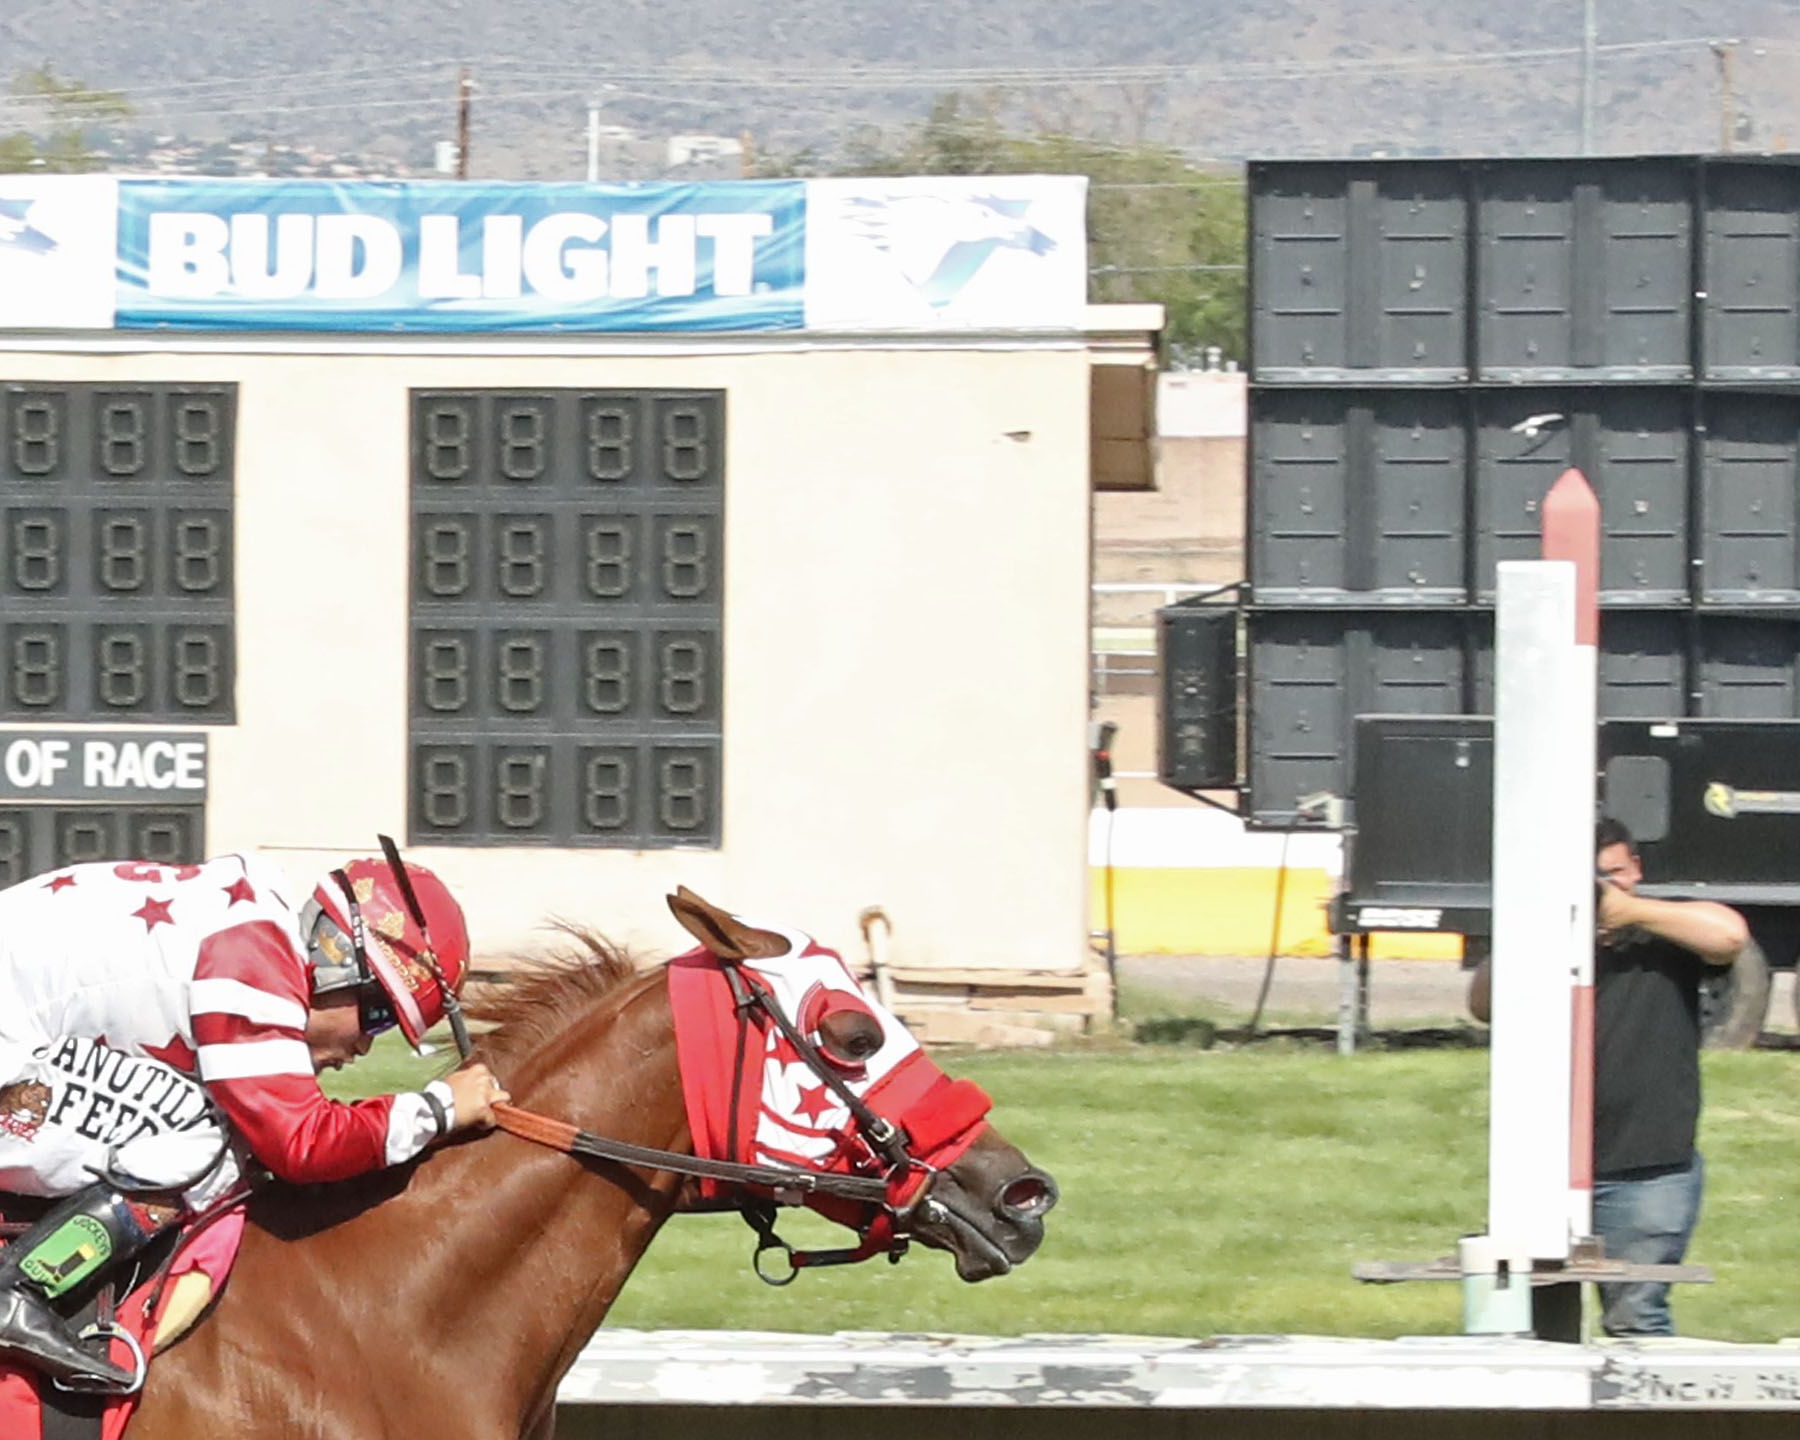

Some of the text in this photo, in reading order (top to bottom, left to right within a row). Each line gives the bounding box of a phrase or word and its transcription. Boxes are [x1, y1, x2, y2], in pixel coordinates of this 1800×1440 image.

[148, 212, 775, 299] BUD LIGHT
[4, 740, 74, 788] OF
[83, 741, 207, 790] RACE
